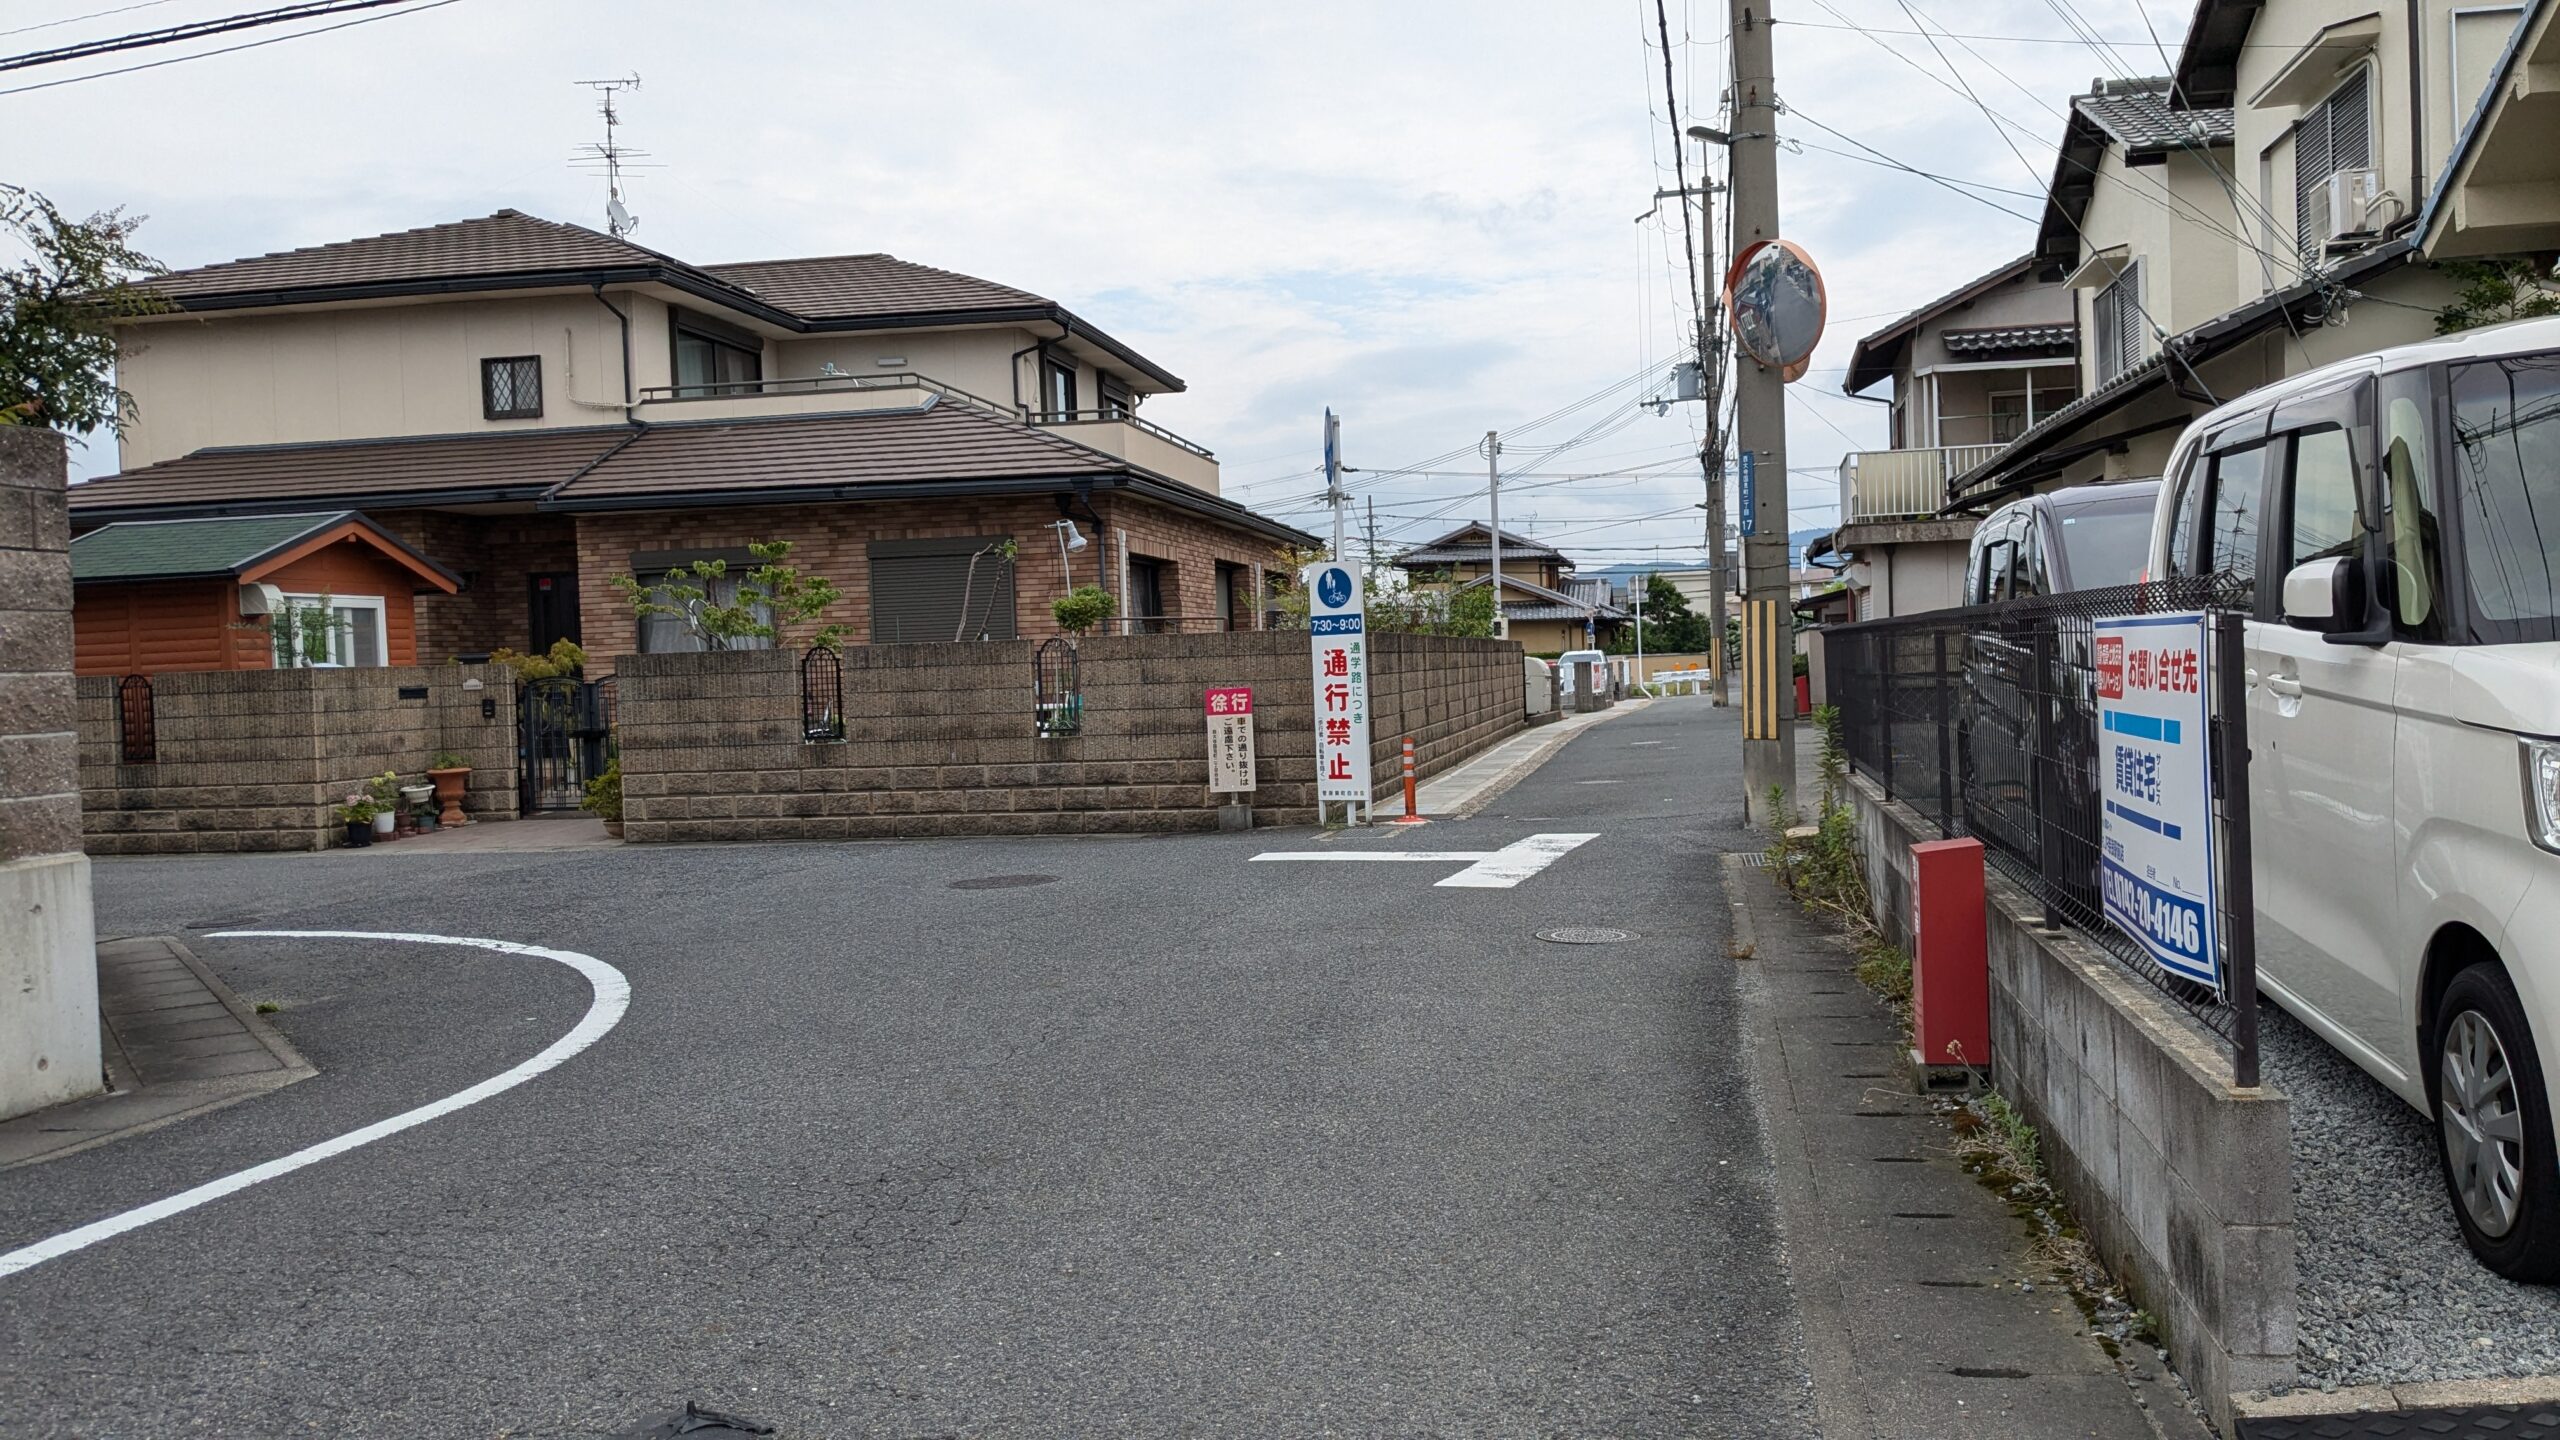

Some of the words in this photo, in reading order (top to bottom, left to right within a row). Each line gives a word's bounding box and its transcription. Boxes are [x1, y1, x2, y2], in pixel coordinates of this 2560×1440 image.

[1742, 520, 1753, 531] 17
[1349, 642, 1362, 724] 通学路につき
[2128, 648, 2198, 694] お問い合せ先
[1211, 693, 1248, 712] 徐行
[1323, 648, 1352, 779] 通行禁止
[1223, 717, 1236, 773] ご遠慮下さい。
[1236, 717, 1249, 786] 車での通り抜けは
[2115, 744, 2156, 803] 賃貸住宅
